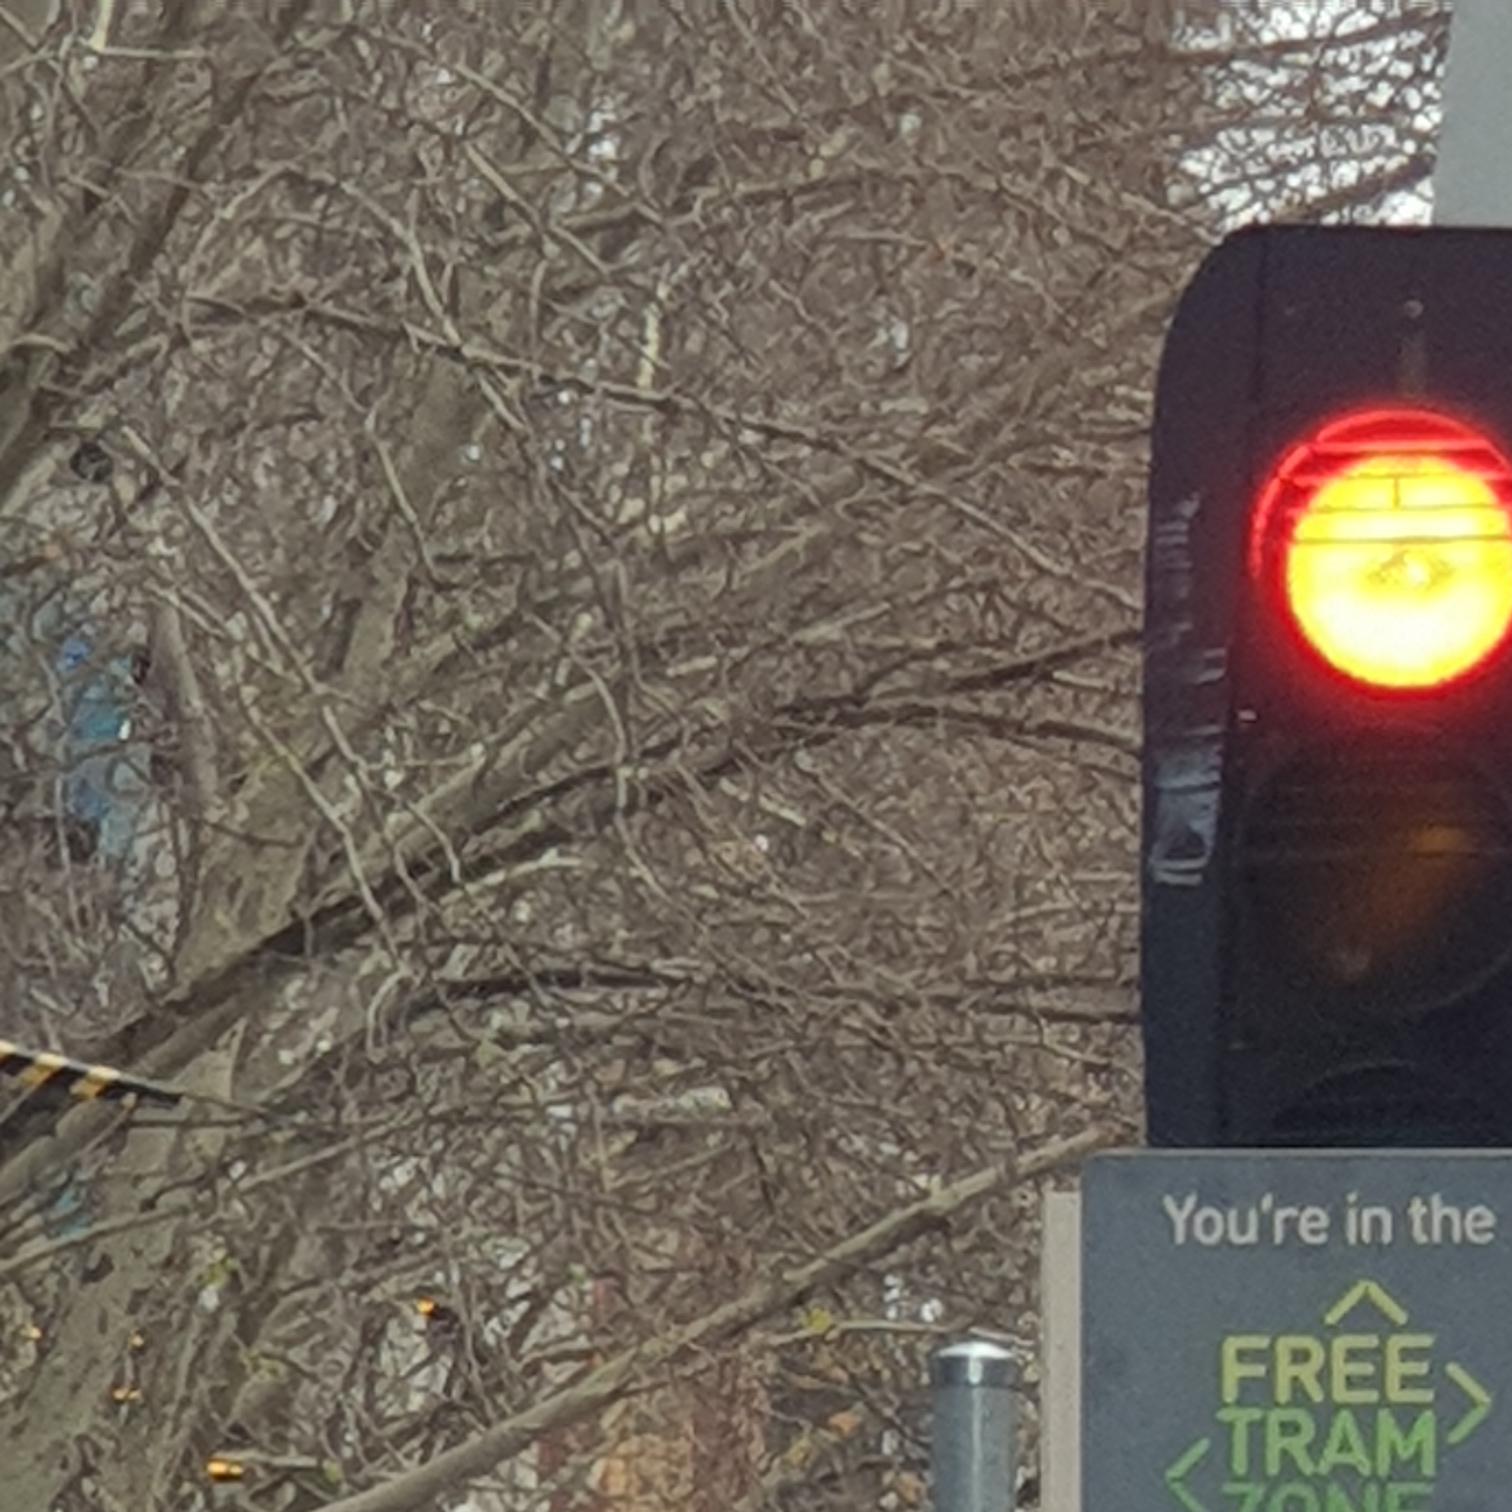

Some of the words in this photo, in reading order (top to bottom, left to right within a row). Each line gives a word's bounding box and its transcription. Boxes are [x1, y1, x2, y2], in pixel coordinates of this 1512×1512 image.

[1163, 1193, 1330, 1245] You're
[1345, 1192, 1392, 1245] in
[1408, 1193, 1496, 1245] the
[1219, 1333, 1437, 1404] FREE
[1216, 1407, 1437, 1477] TRAM
